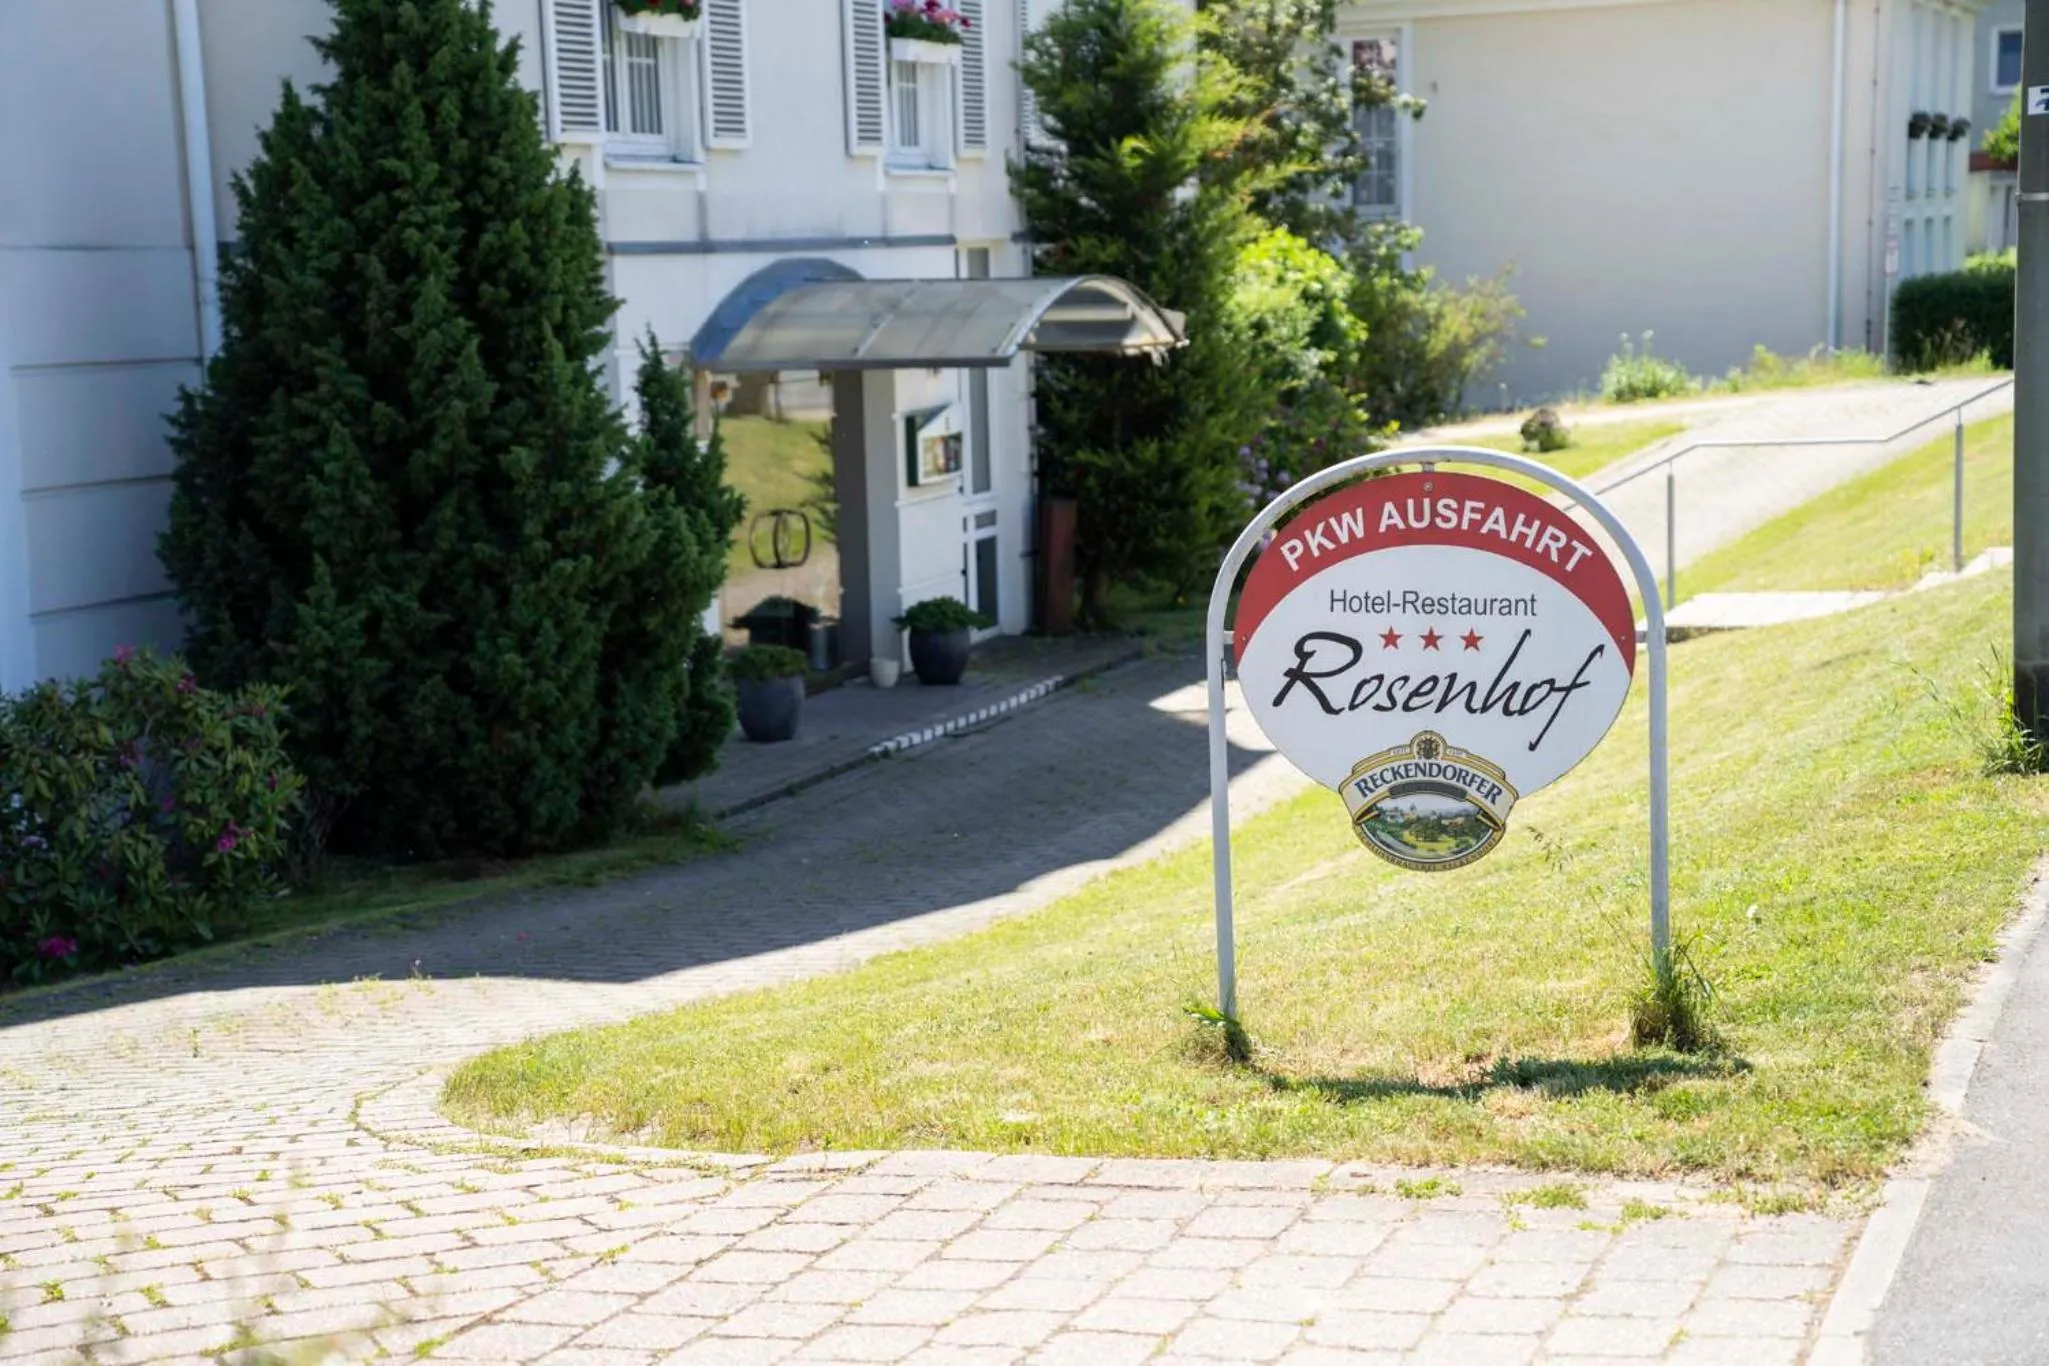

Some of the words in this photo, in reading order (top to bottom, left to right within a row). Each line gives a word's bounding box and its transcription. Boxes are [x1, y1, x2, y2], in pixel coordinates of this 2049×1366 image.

[1280, 508, 1364, 571] PKW
[1379, 498, 1592, 572] AUSFAHRT
[1330, 589, 1537, 616] Hotel-Restaurant
[1272, 629, 1605, 751] Rosenhof
[1354, 762, 1503, 805] RECKENDORFER
